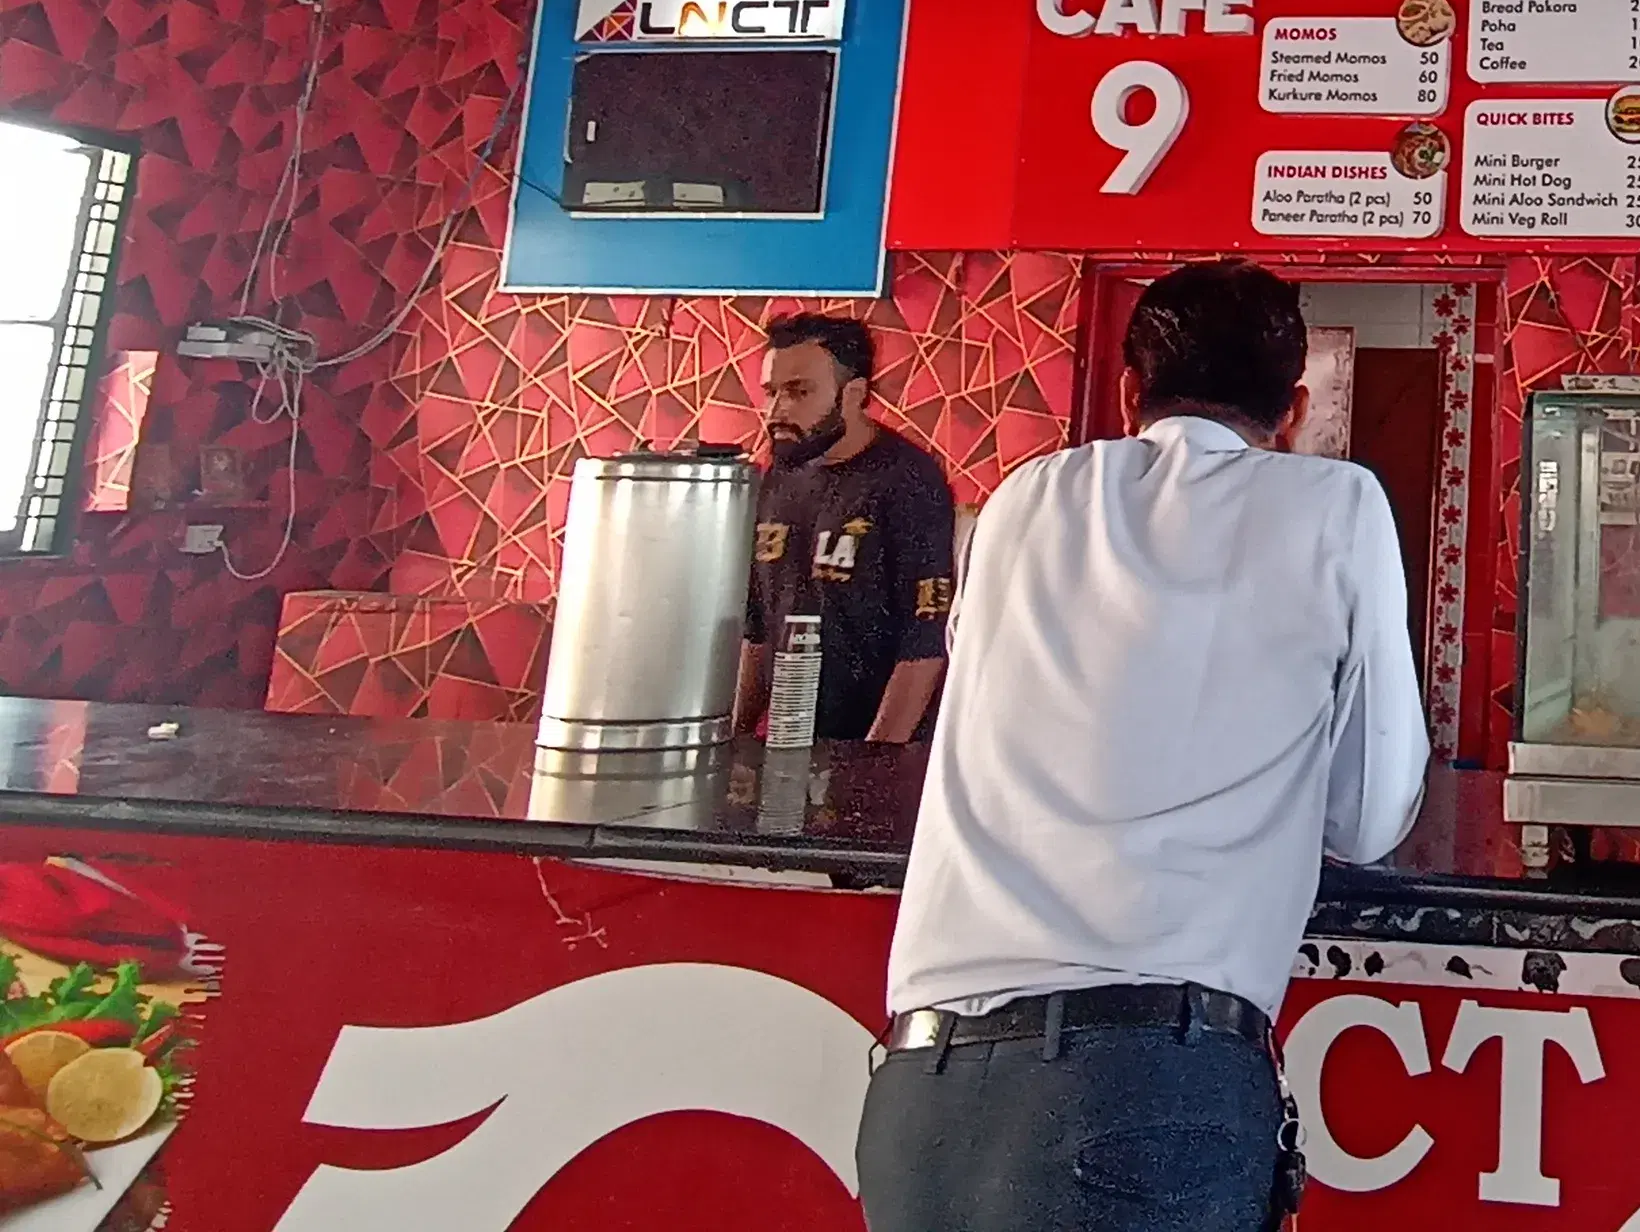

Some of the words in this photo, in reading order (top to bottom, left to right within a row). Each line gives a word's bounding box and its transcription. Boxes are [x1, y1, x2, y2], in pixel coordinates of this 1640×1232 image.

[1482, 0, 1524, 14] Bread
[1528, 0, 1577, 13] Pakora
[639, 0, 830, 35] LNCT
[1481, 19, 1516, 32] Poha
[1274, 28, 1337, 41] MOMOS
[1480, 38, 1504, 52] Tea
[1271, 51, 1332, 64] Steamed
[1335, 52, 1387, 64] Momos
[1420, 51, 1439, 65] 50
[1479, 56, 1527, 70] Coffee
[1270, 69, 1304, 82] Fried
[1307, 70, 1359, 83] Momos
[1419, 70, 1438, 84] 60
[1268, 87, 1323, 101] Kurkure
[1325, 88, 1378, 102] Momos
[1417, 89, 1437, 103] 80
[1476, 112, 1528, 126] QUICK
[1532, 112, 1574, 125] BITES
[1090, 60, 1190, 197] 9
[1474, 154, 1506, 167] Mini
[1511, 154, 1560, 171] Burger
[1267, 165, 1327, 178] INDIAN
[1331, 166, 1387, 180] DISHES
[1473, 173, 1506, 186] Mini
[1510, 173, 1536, 187] Hot
[1541, 173, 1571, 190] Dog
[1262, 189, 1293, 203] Aloo
[1296, 189, 1345, 204] Paratha
[1413, 191, 1432, 205] 50
[1472, 192, 1505, 206] Mini
[1508, 192, 1543, 207] Aloo
[1547, 192, 1618, 207] Sandwich
[1262, 208, 1306, 222] Paneer
[1309, 209, 1358, 224] Paratha
[1412, 211, 1431, 224] 70
[1472, 212, 1504, 225] Mini
[1508, 212, 1536, 229] Veg
[1541, 212, 1567, 226] Roll
